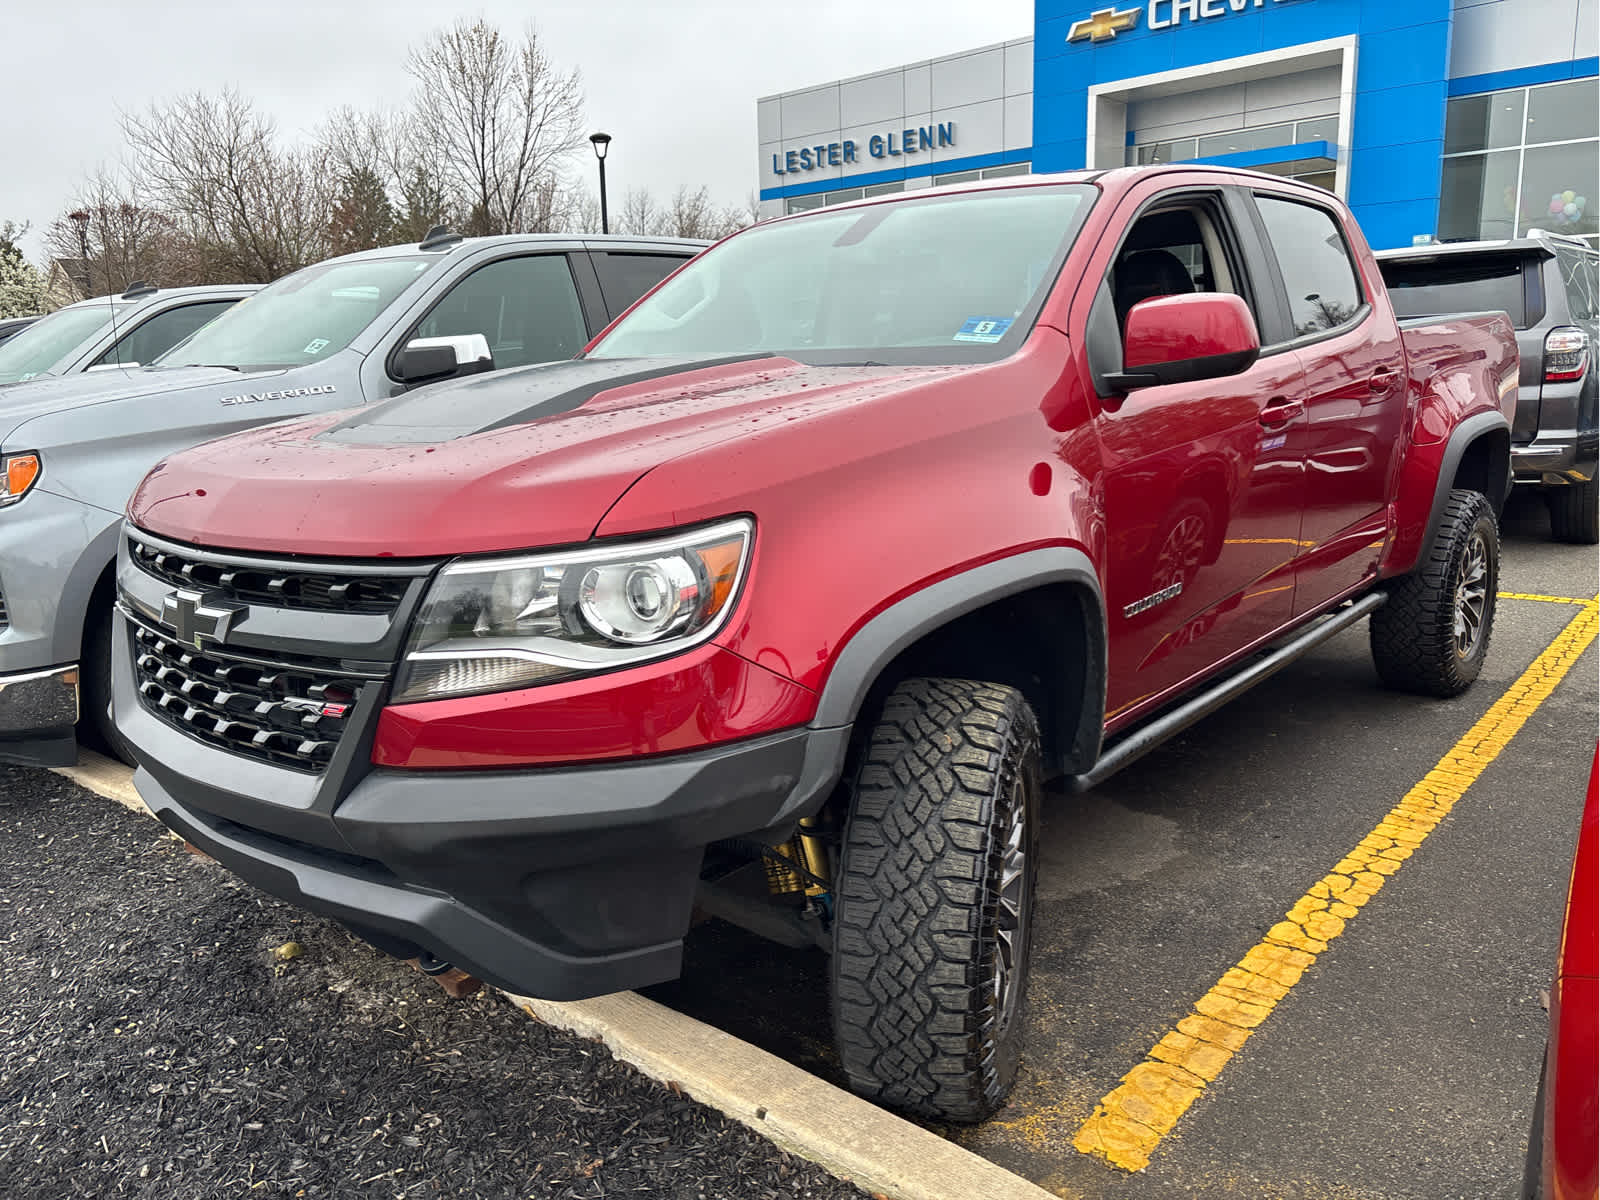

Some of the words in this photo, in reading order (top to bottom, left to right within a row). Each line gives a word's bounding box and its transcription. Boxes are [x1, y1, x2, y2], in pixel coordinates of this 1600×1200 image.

[1148, 0, 1287, 30] CHE
[773, 140, 856, 175] LESTER
[869, 122, 953, 159] GLENN
[221, 384, 337, 407] SILVERADO
[1123, 582, 1183, 618] COLORADO
[281, 696, 348, 718] ZR2
